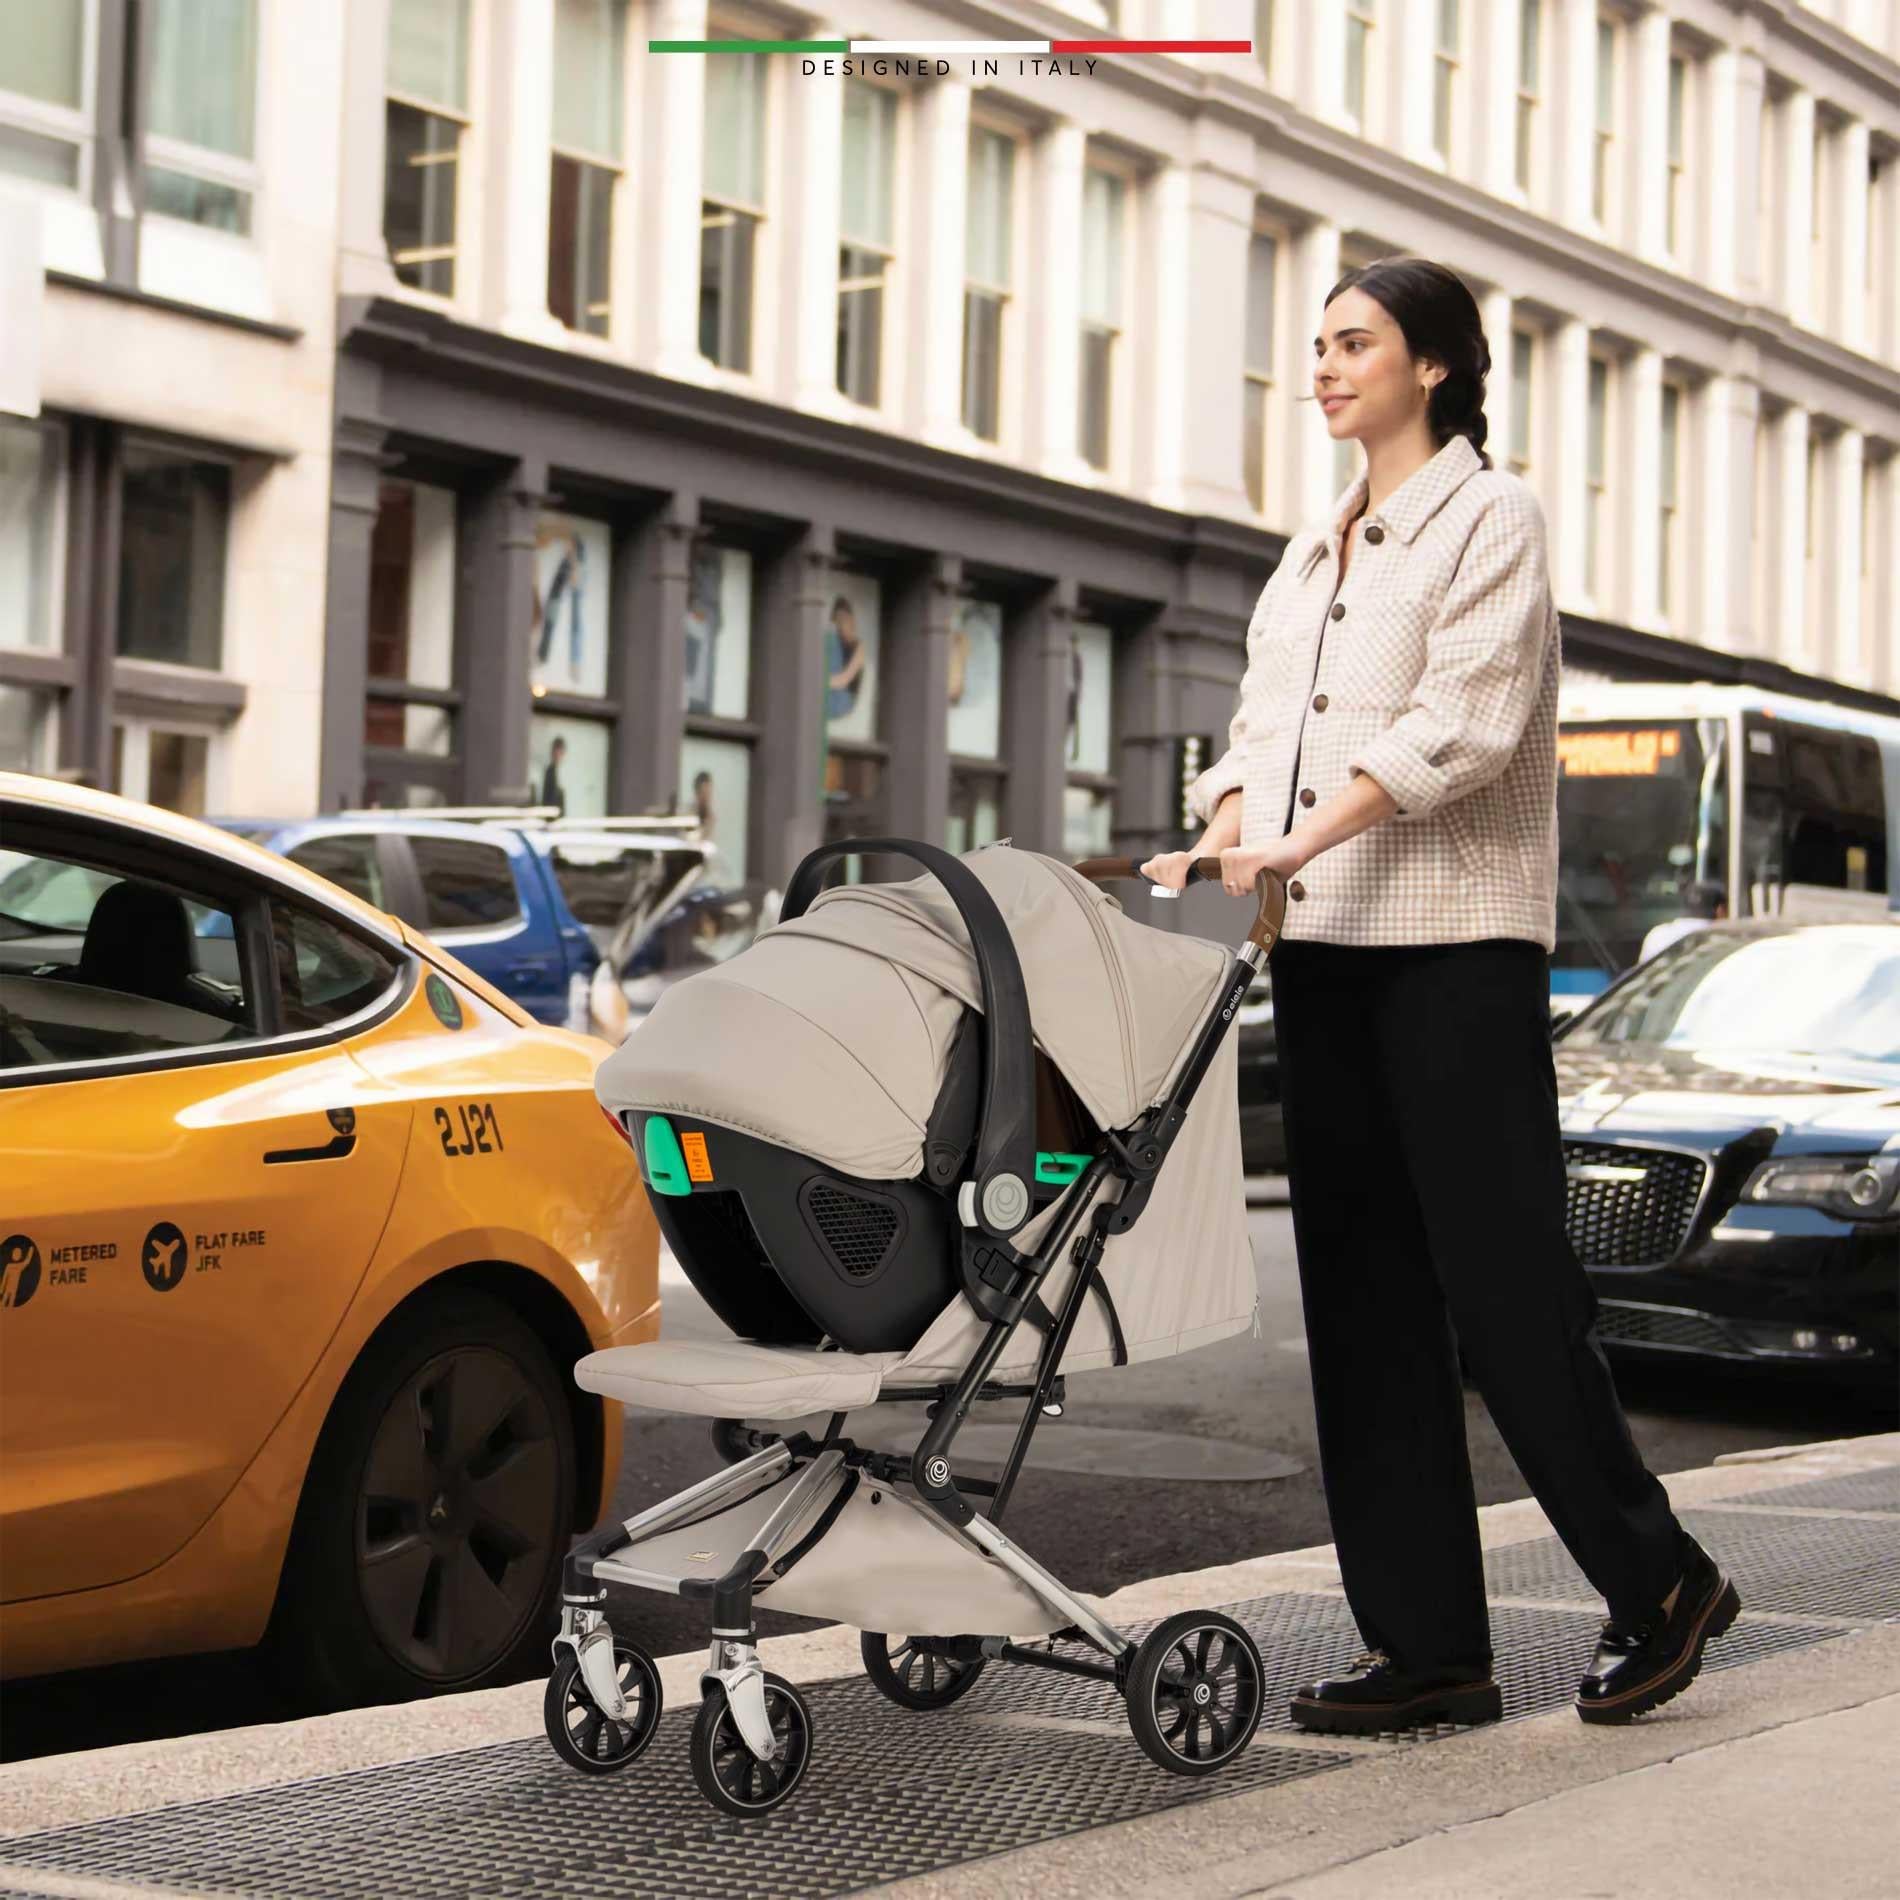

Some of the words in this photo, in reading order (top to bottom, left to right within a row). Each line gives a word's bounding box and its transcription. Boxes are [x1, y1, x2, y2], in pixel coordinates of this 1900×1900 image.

[434, 1103, 504, 1157] 2J21
[195, 1233, 228, 1251] FLAT
[231, 1230, 266, 1247] FARE
[50, 1243, 118, 1264] METERED
[195, 1255, 222, 1273] JFK
[50, 1266, 88, 1286] FARE
